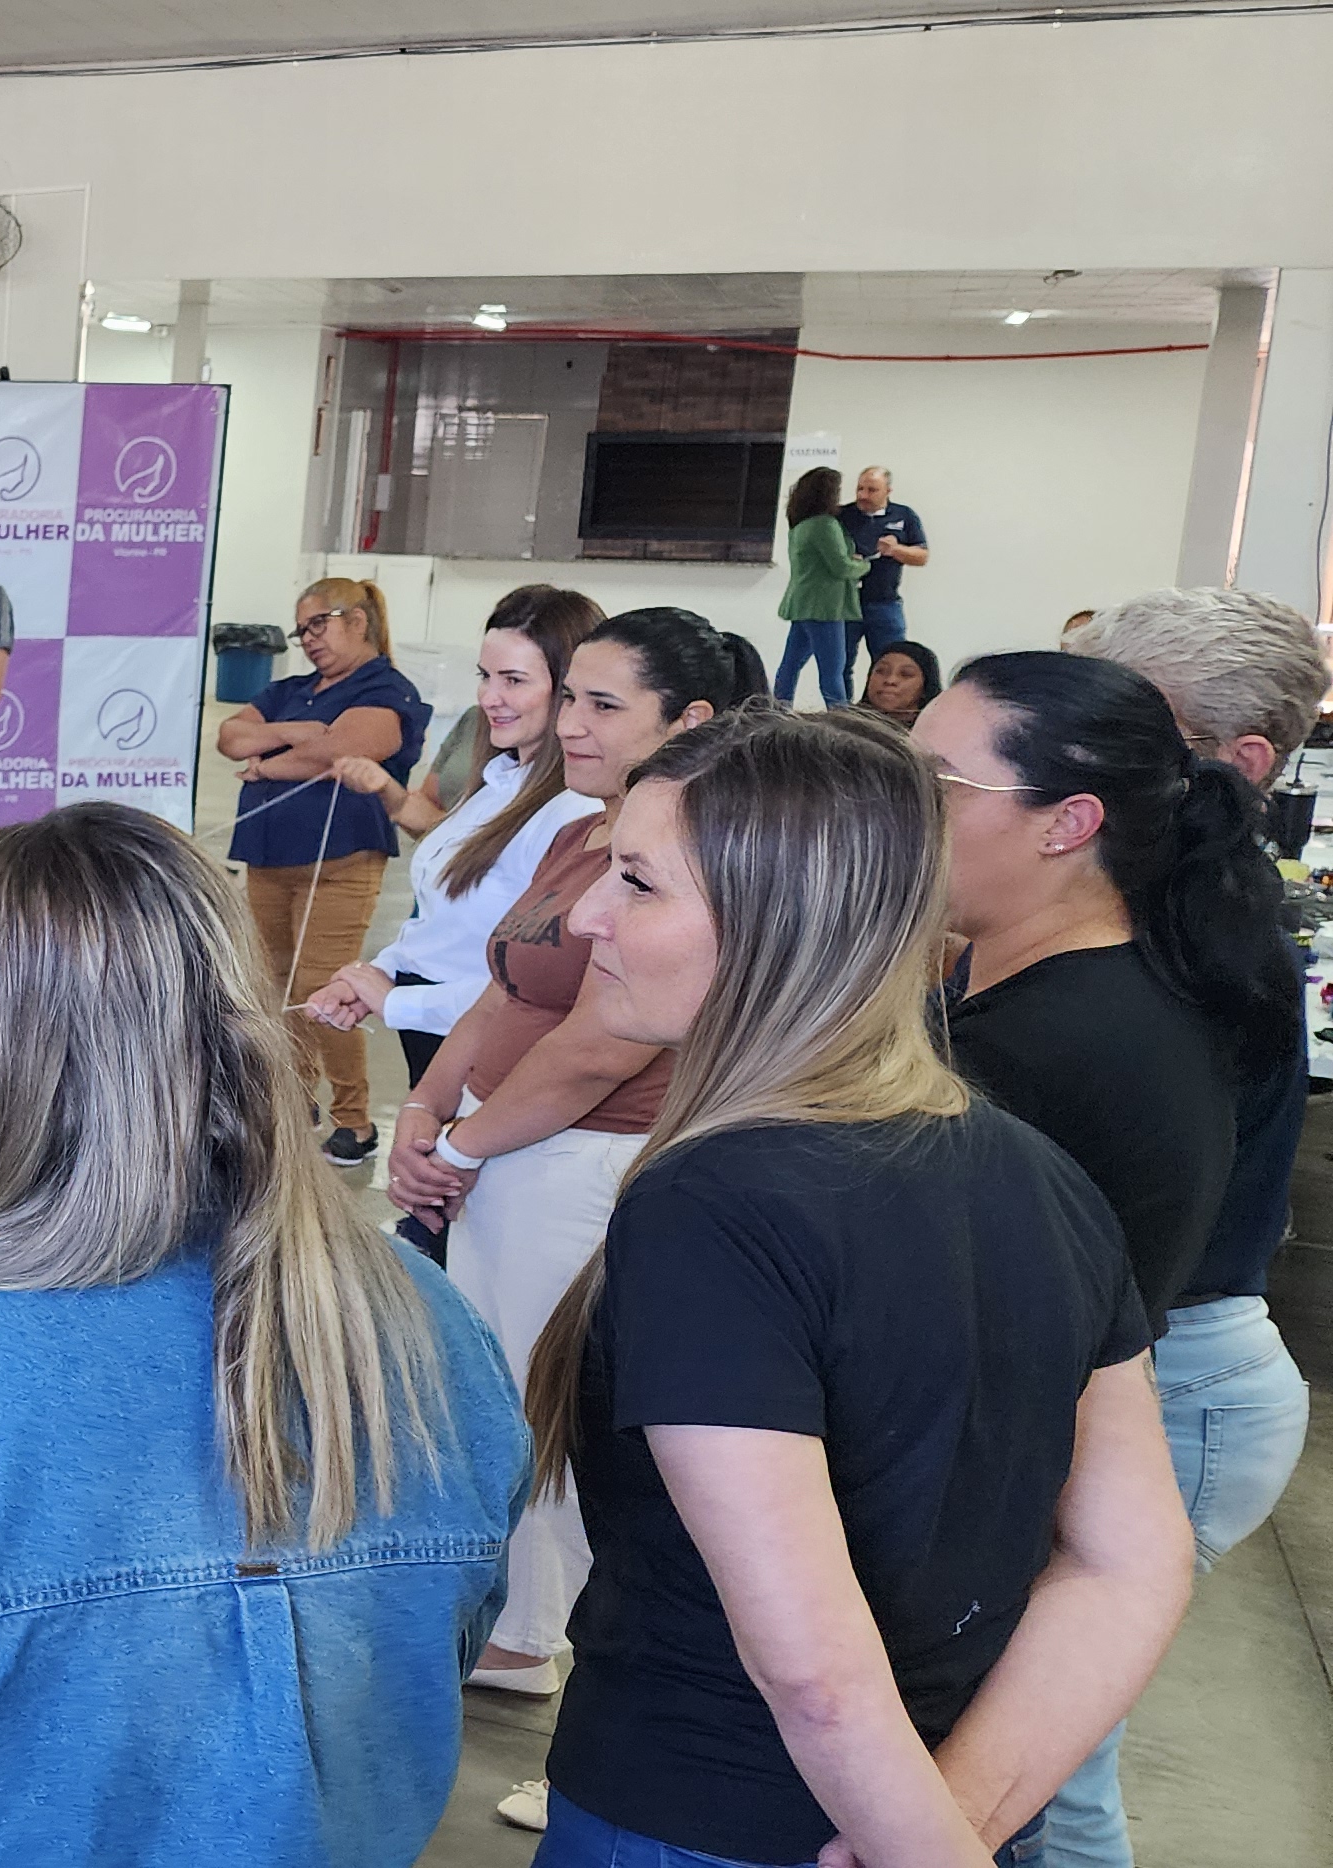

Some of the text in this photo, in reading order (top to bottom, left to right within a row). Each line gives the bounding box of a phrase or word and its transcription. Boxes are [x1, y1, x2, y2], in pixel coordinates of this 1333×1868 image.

[83, 507, 198, 522] PROCURADORIA
[75, 522, 205, 542] DA MULHER
[60, 771, 188, 788] DA MULHER
